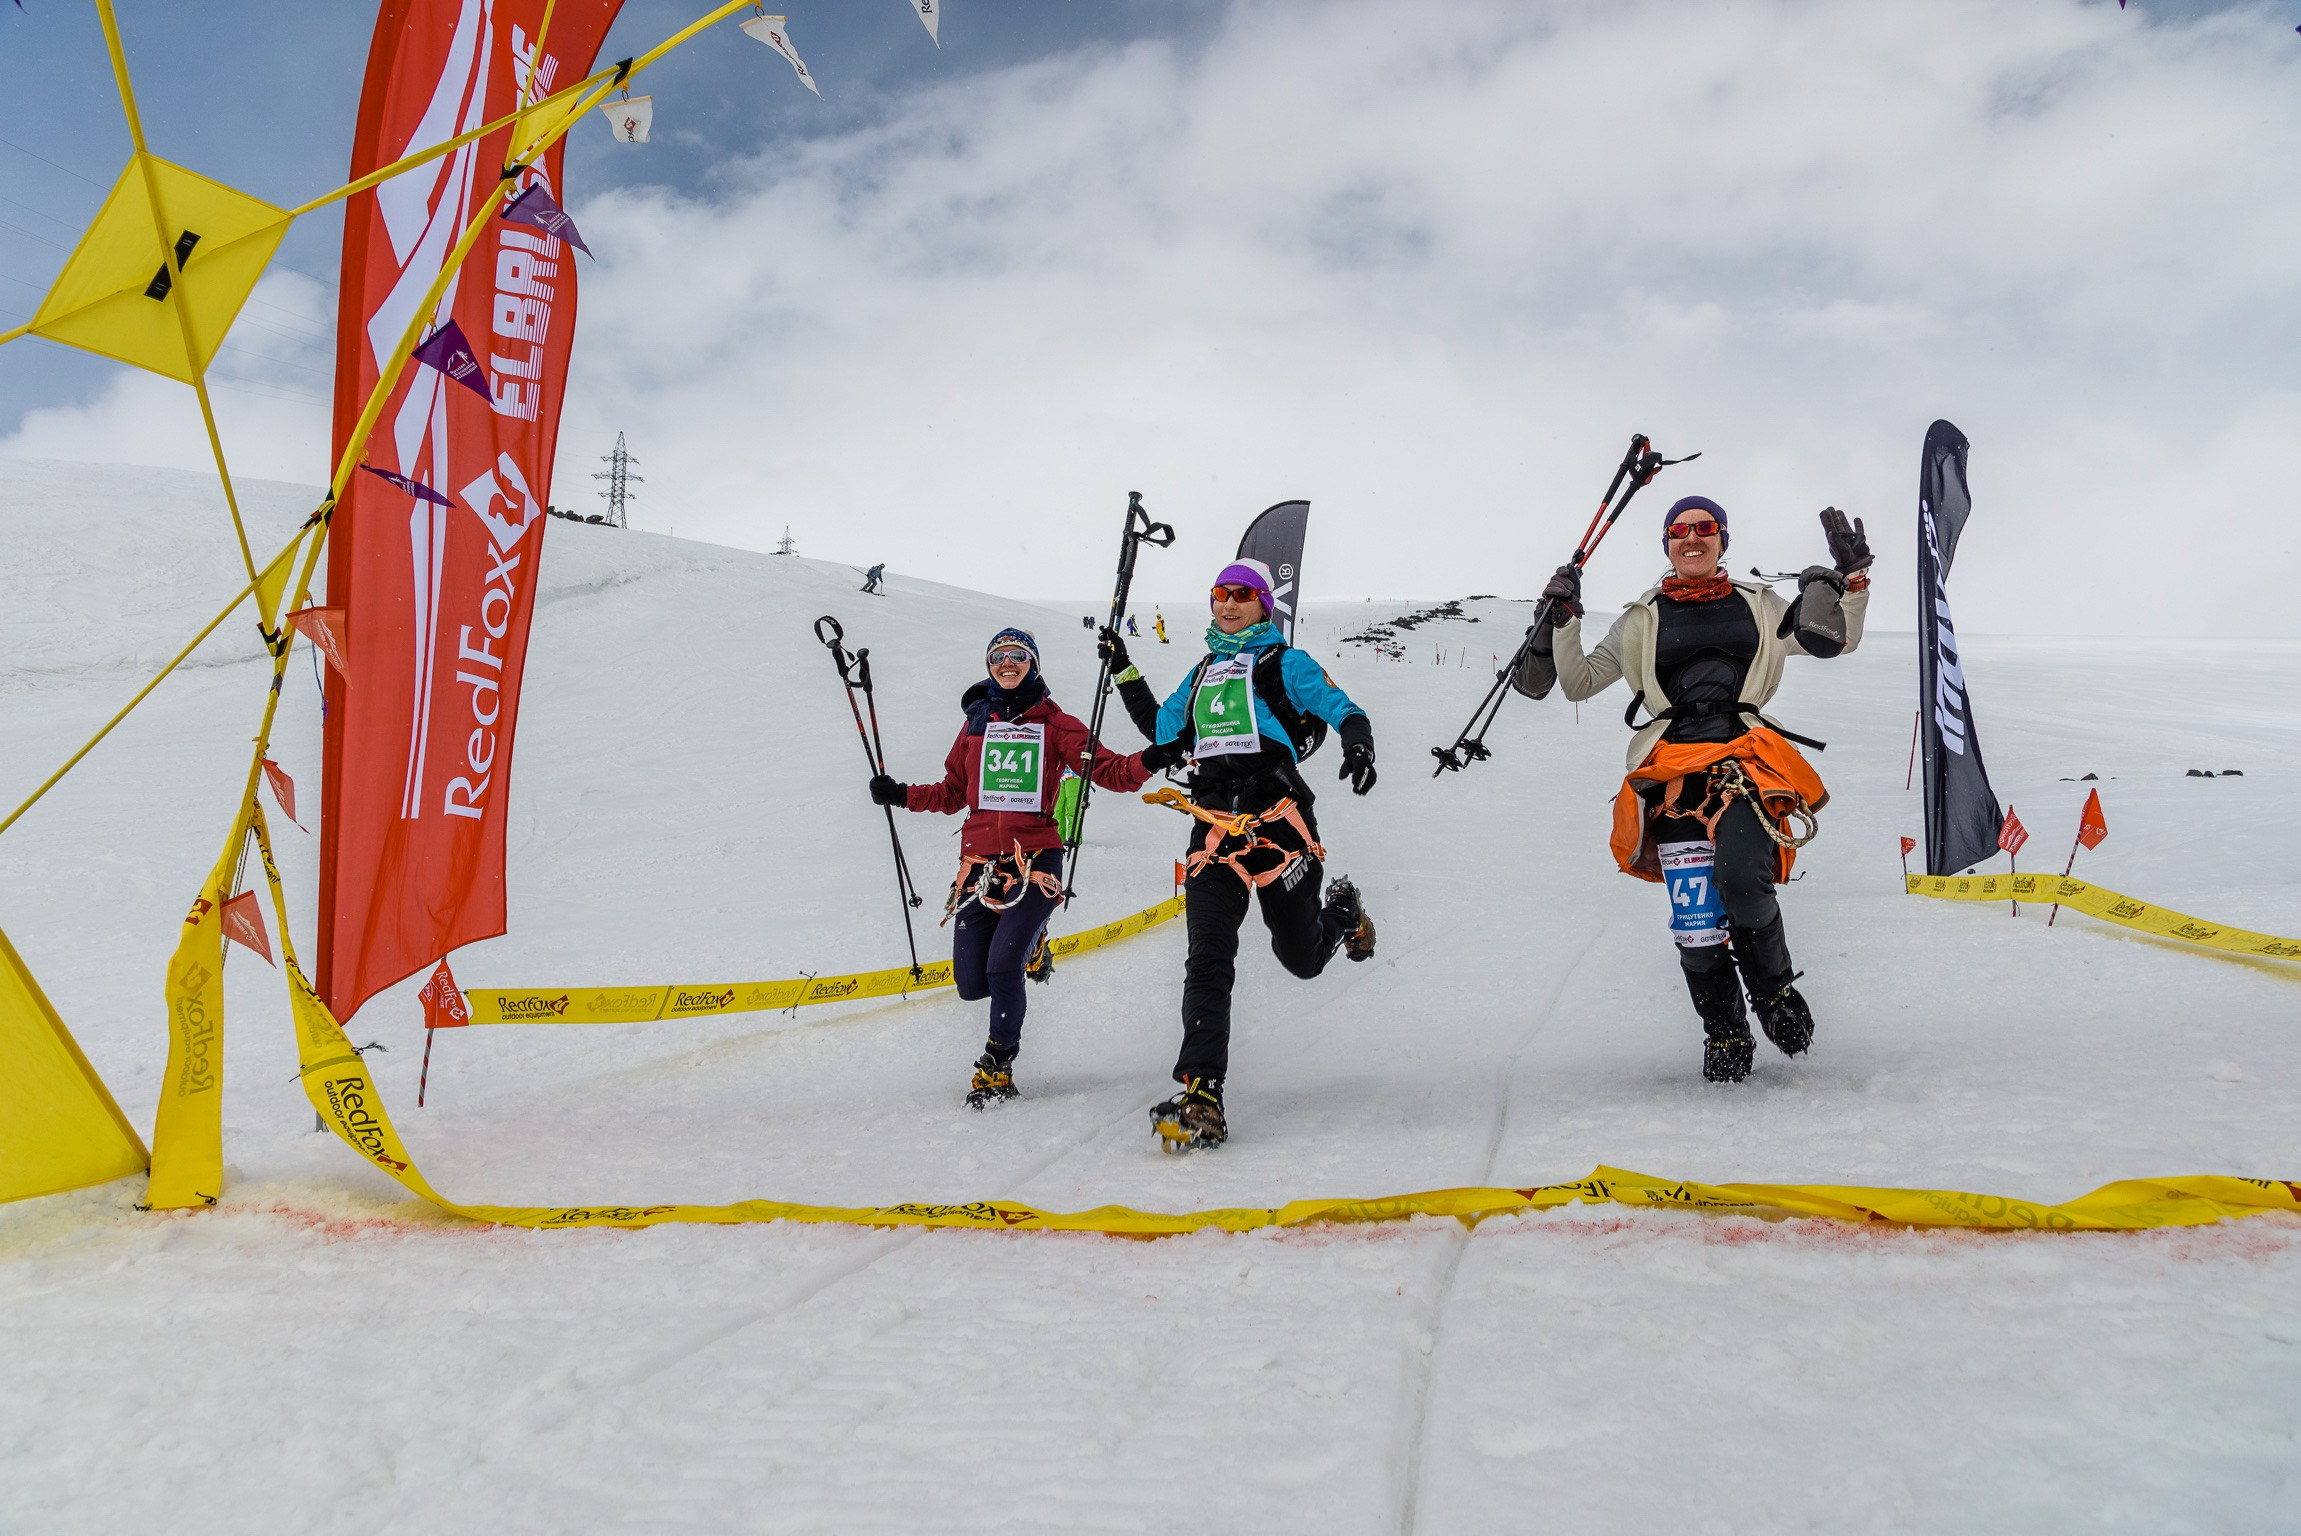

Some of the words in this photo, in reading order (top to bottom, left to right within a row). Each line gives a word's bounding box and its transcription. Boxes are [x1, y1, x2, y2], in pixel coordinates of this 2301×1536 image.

[443, 539, 522, 821] RedFox
[1210, 691, 1225, 716] 4
[987, 749, 1032, 773] 341
[1672, 876, 1708, 907] 47
[674, 991, 721, 1007] RedFox
[811, 981, 848, 995] RedFox
[498, 997, 551, 1013] RedFox
[502, 1013, 525, 1021] outdoor
[671, 1004, 691, 1013] outdoor
[691, 1003, 718, 1012] equipment
[324, 1080, 344, 1119] outdoor
[335, 1077, 391, 1158] RedFox
